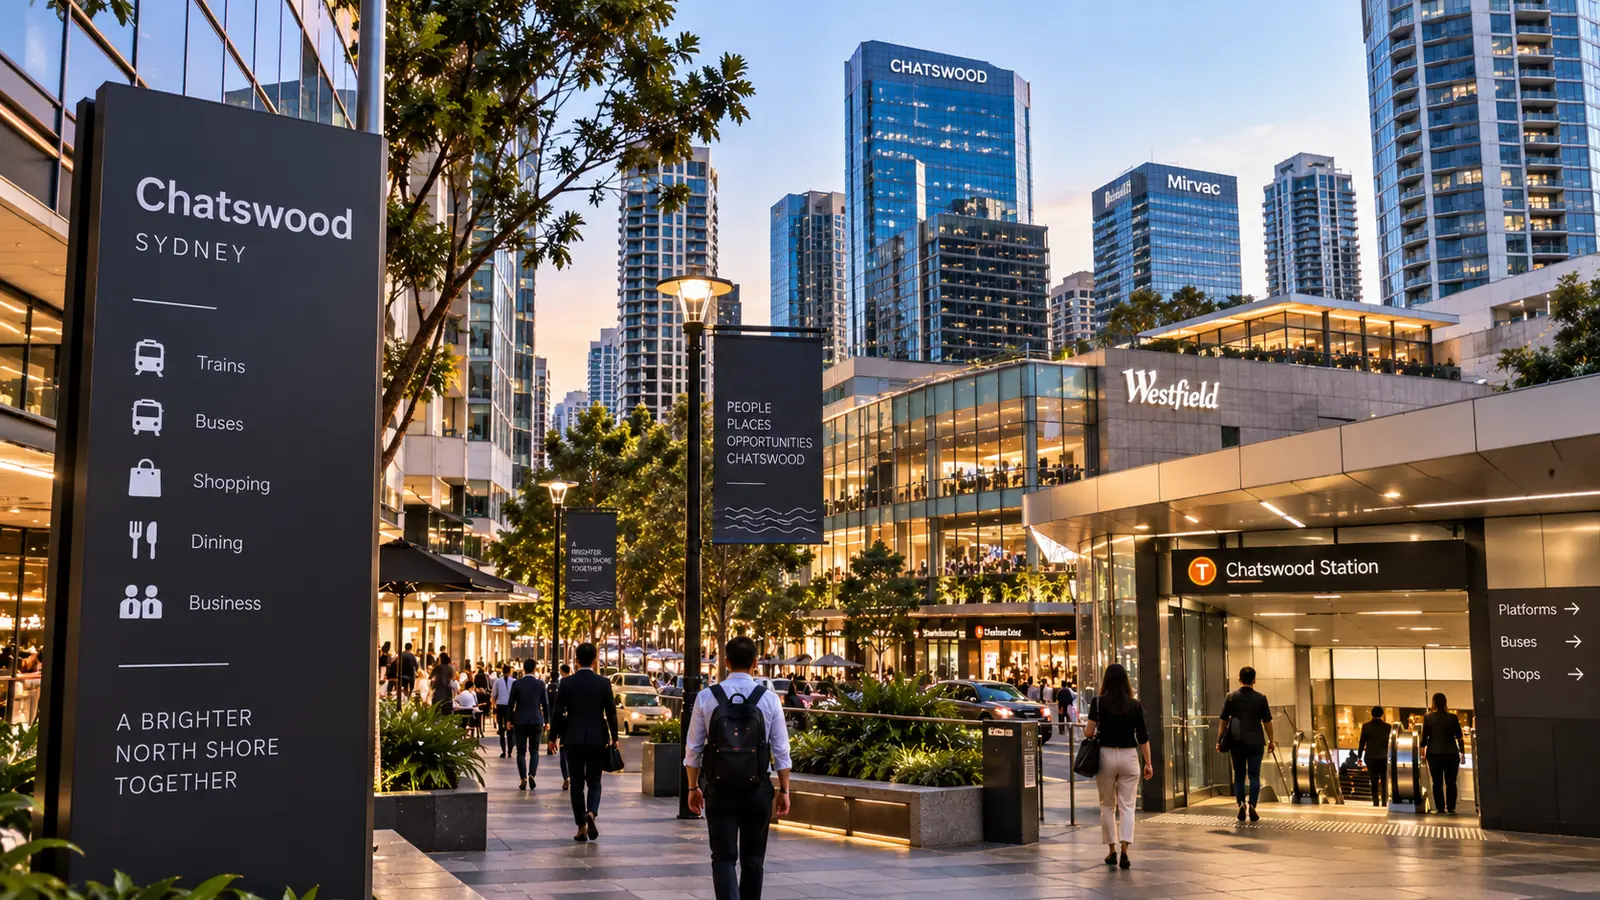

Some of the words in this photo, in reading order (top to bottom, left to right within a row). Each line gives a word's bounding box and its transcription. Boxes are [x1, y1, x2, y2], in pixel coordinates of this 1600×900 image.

[890, 59, 988, 83] CHATSWOOD
[1167, 174, 1221, 195] Mirvac
[136, 177, 353, 240] Chatswood
[135, 232, 246, 263] SYDNEY
[197, 355, 246, 374] Trains
[1122, 368, 1220, 410] Westfield
[727, 401, 772, 414] PEOPLE
[195, 413, 244, 431] Buses
[727, 418, 772, 431] PLACES
[726, 435, 813, 449] OPPORTUNITIES
[726, 453, 805, 465] CHATSWOOD
[193, 473, 271, 496] Shopping
[191, 533, 243, 554] Dining
[1195, 563, 1210, 581] T
[1226, 560, 1315, 578] Chatswood
[1320, 559, 1379, 576] Station
[189, 595, 262, 611] Business
[1499, 603, 1558, 616] Platforms
[1500, 635, 1538, 648] Buses
[1502, 668, 1541, 683] Shops
[116, 713, 131, 732] A
[141, 709, 252, 731] BRIGHTER
[116, 742, 197, 763] NORTH
[206, 738, 279, 759] SHORE
[114, 771, 237, 795] TOGETHER
